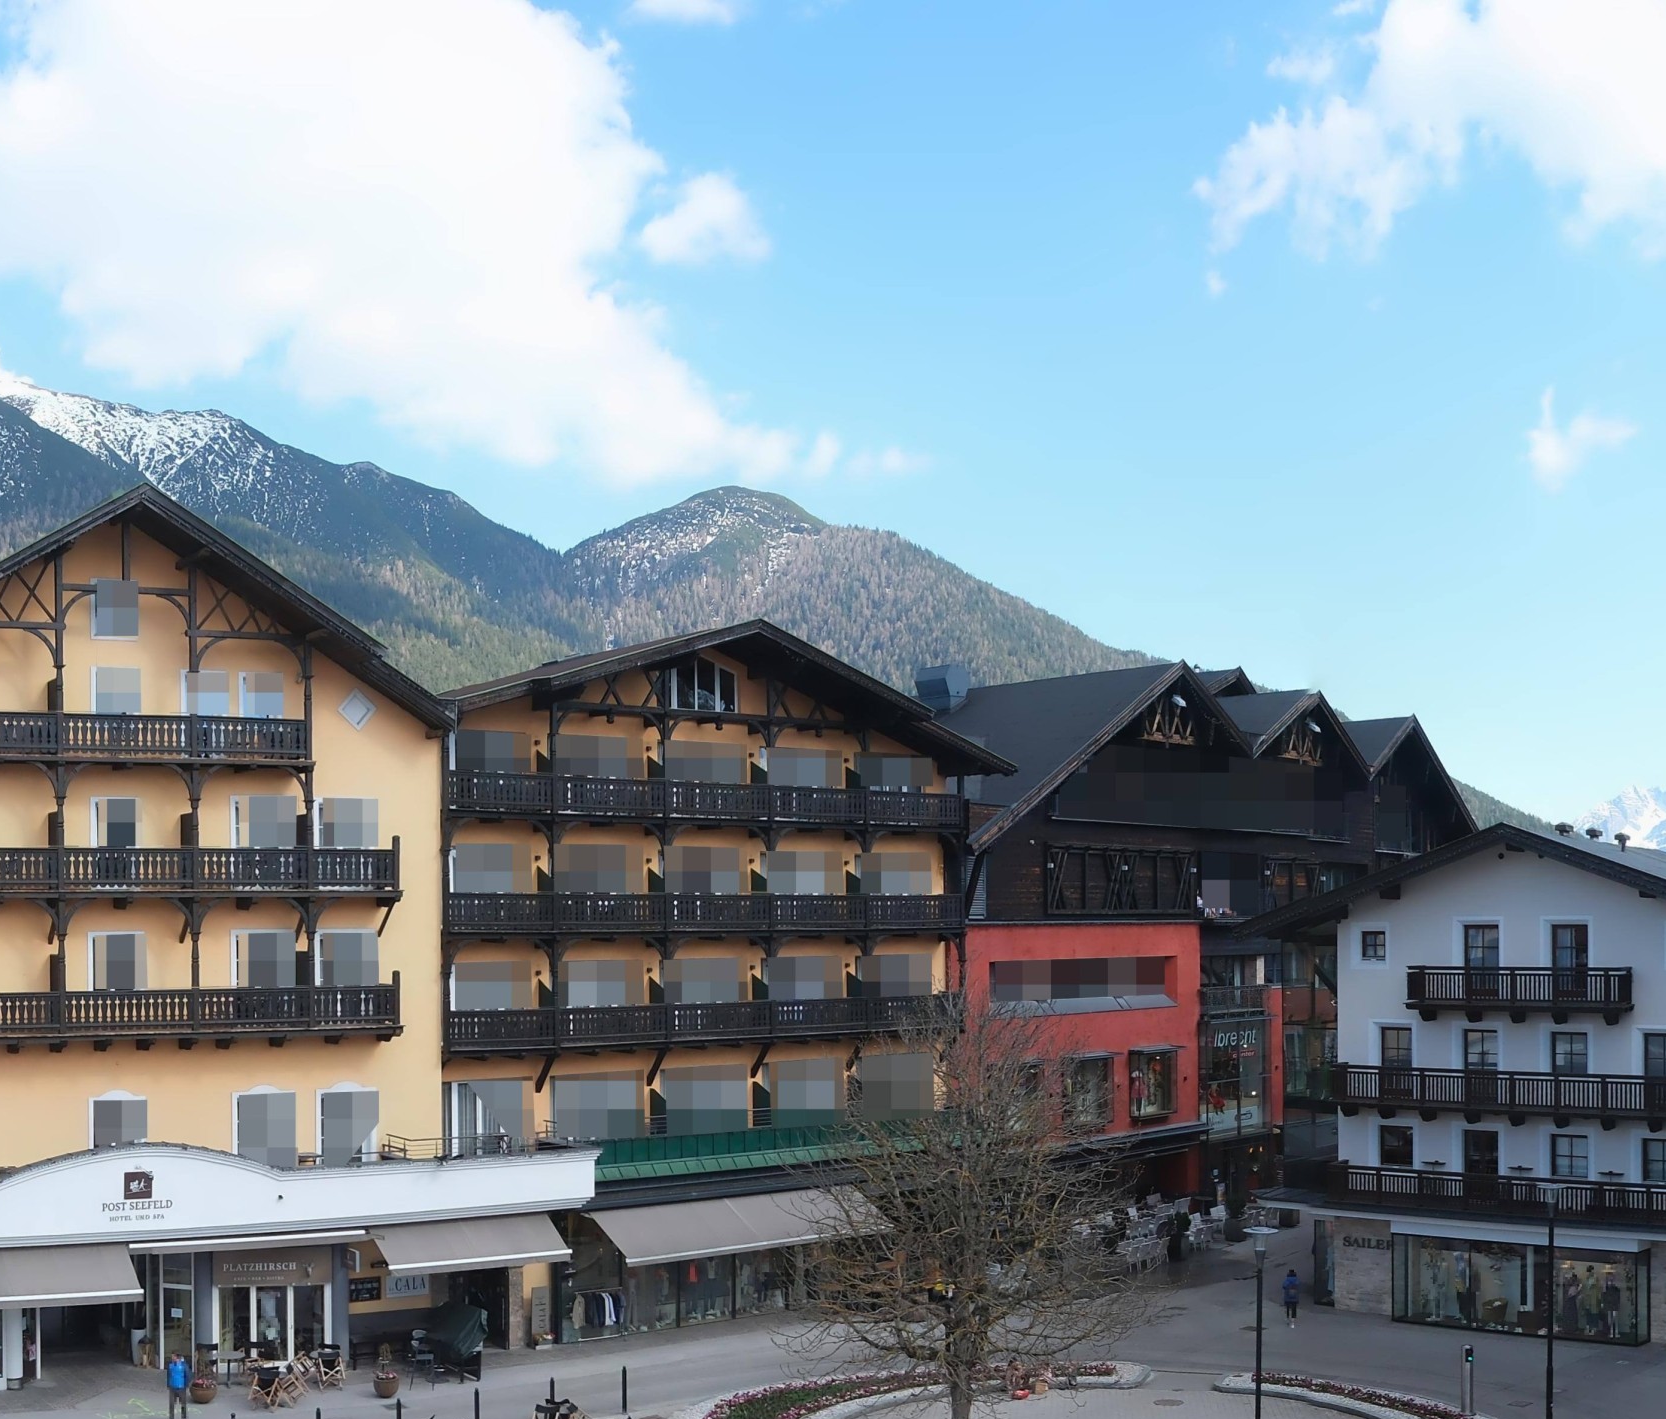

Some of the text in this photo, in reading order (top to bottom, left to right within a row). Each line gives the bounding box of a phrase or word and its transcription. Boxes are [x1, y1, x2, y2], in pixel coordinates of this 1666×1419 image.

[102, 1200, 173, 1212] POST SEEFELD
[223, 1262, 297, 1272] PLATZHIRSCH
[395, 1276, 426, 1291] CALA
